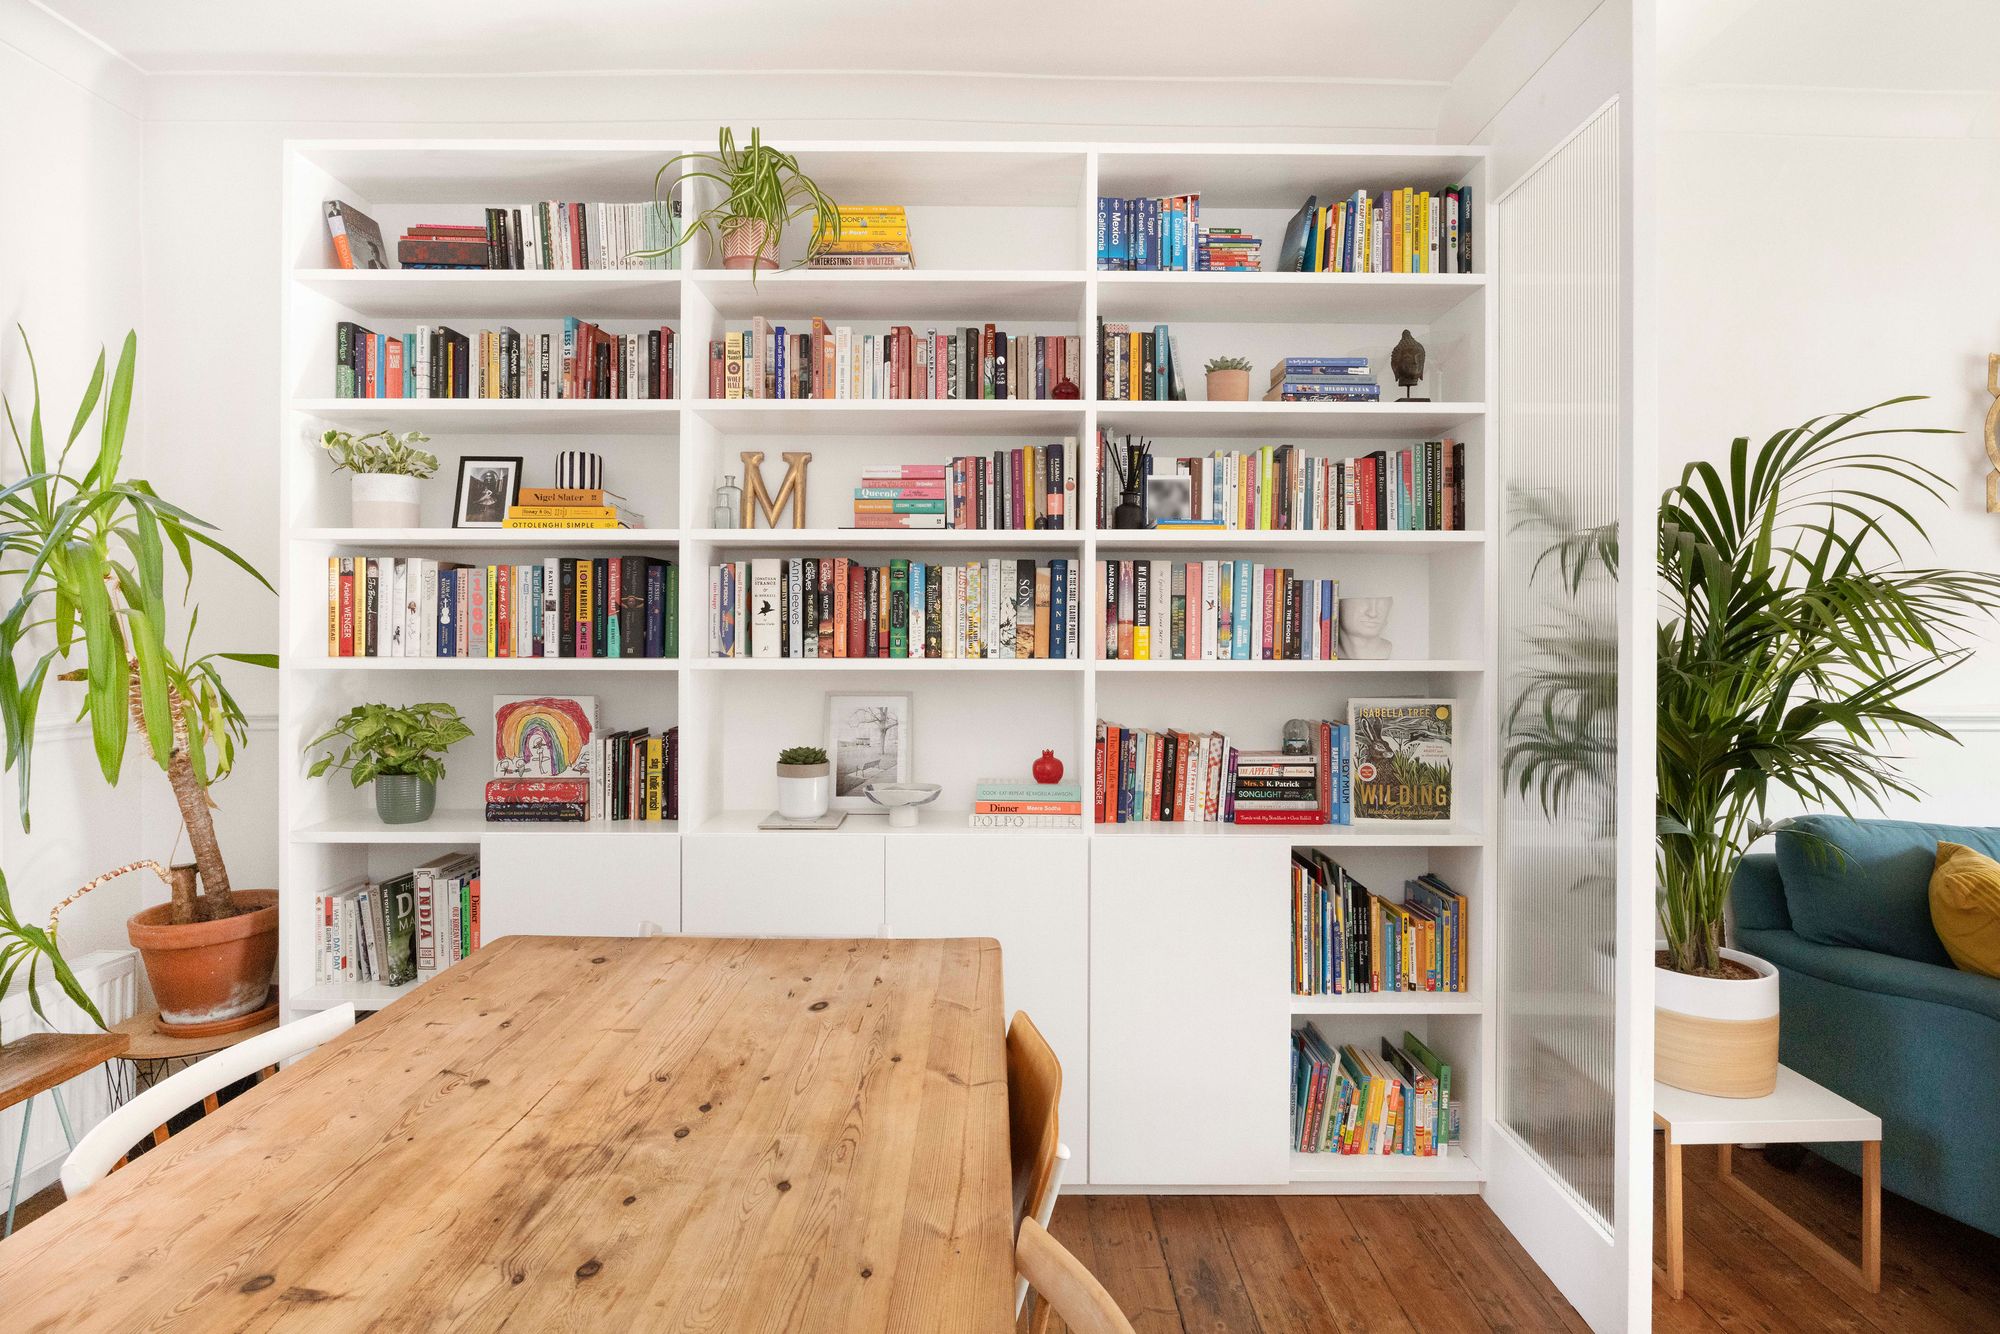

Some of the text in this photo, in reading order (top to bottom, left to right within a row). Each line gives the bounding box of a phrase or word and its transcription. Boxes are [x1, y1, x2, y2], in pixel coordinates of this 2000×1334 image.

[1112, 212, 1121, 244] Mexico
[866, 256, 894, 266] WOLITZER
[534, 494, 556, 502] Nigel
[740, 452, 812, 529] M
[861, 488, 898, 498] Queenie
[821, 562, 829, 591] Cleeves
[1138, 566, 1146, 576] MY
[791, 560, 802, 625] Ann Cleeves
[836, 560, 845, 624] Ann Cleeves
[958, 570, 966, 602] LUSTER
[1019, 579, 1030, 607] SON
[564, 588, 572, 610] Homo
[1264, 583, 1273, 643] CINEMA LOVE
[1360, 708, 1430, 718] ISABELLA TREE
[648, 758, 660, 810] slug hollie mcnish
[1249, 767, 1274, 776] APPEAL
[1361, 783, 1447, 806] WILDING
[989, 804, 1019, 813] Dinner
[972, 815, 1024, 828] POLPO
[419, 887, 432, 940] INDIA
[471, 895, 480, 923] Dinner
[1440, 1090, 1450, 1110] LION
